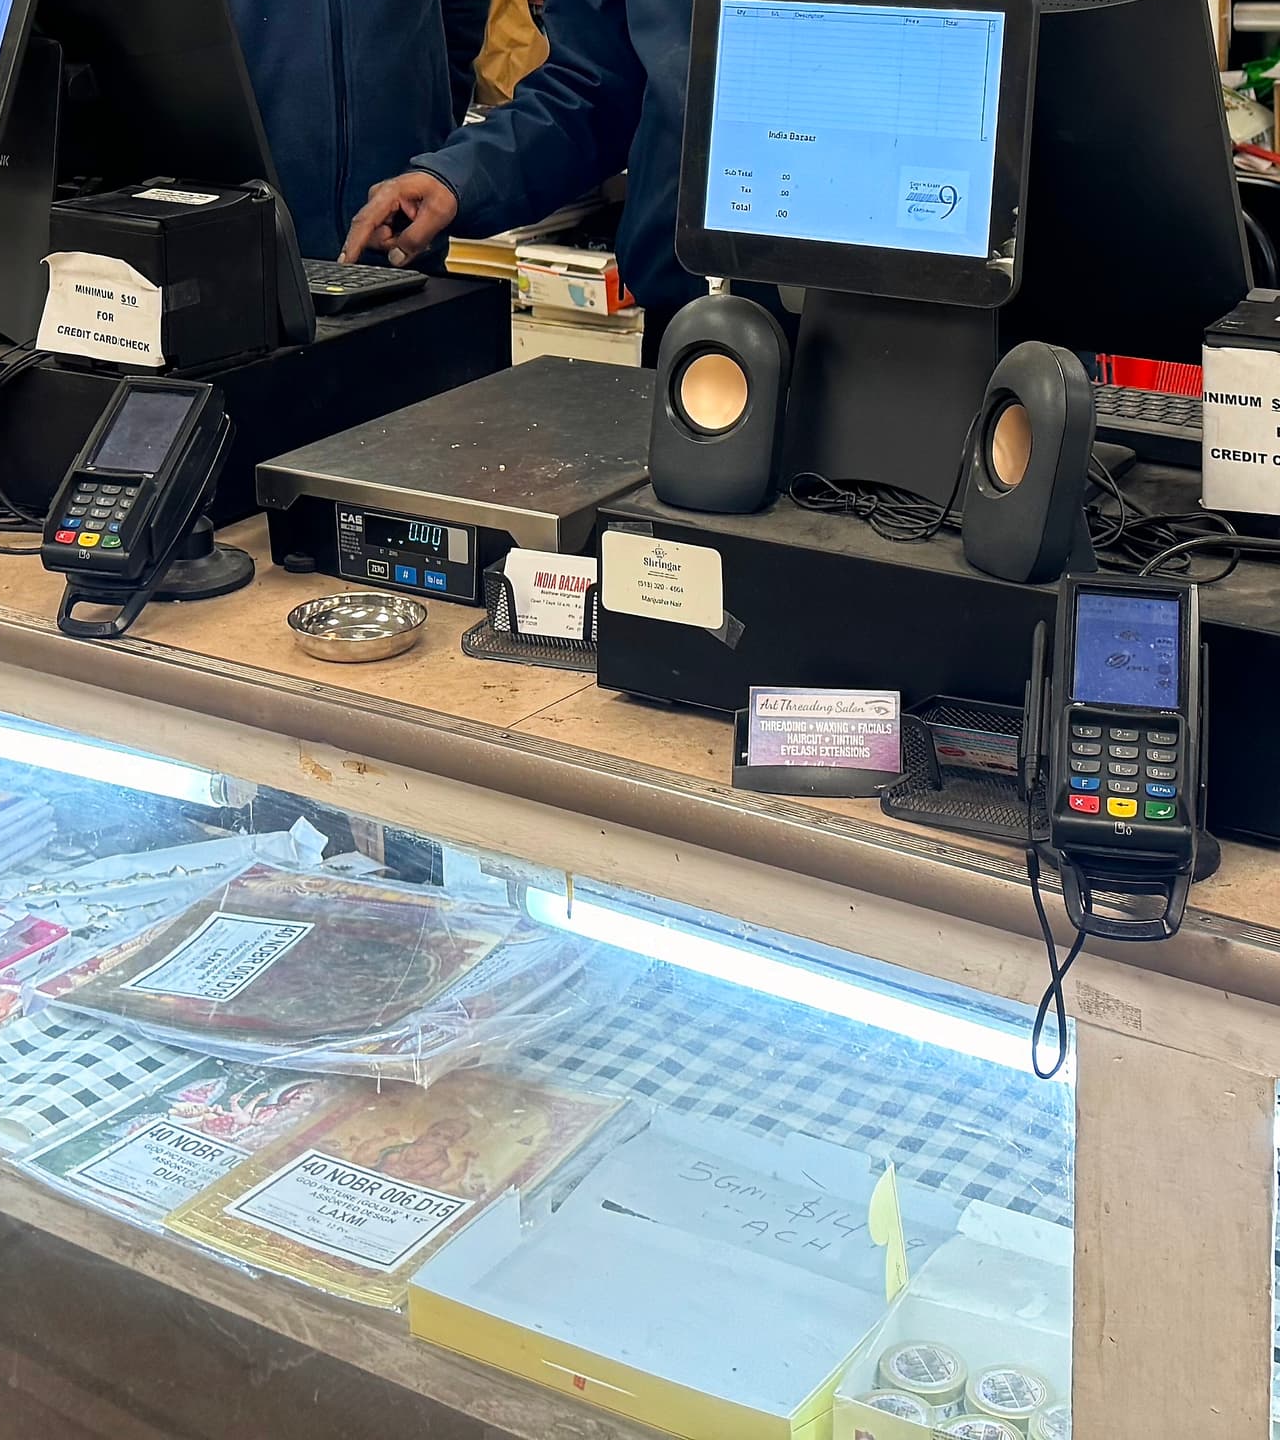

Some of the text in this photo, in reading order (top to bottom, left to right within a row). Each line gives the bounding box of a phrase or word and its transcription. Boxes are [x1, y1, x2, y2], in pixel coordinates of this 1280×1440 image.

[768, 130, 817, 143] India Bazaar
[724, 169, 753, 178] Sub Total
[731, 202, 751, 212] Total
[75, 284, 139, 307] MINIMUM $10
[96, 311, 114, 322] FOR
[57, 325, 91, 341] CREDIT
[1203, 391, 1262, 408] INIMUM
[1210, 448, 1268, 465] CREDIT
[340, 512, 363, 525] CAS
[409, 521, 442, 546] 0.00
[371, 564, 385, 574] ZERO
[643, 557, 682, 573] Shringar
[534, 571, 556, 589] INDIA
[760, 698, 866, 715] Art Threading Salon
[760, 722, 892, 734] THREADING WAXING FACIALS
[787, 734, 864, 746] HAIRCUT TINTING
[780, 745, 870, 758] EYELASH EXTENSIONS
[148, 1127, 224, 1162] 40 NOBR
[152, 1167, 205, 1192] DURGA
[295, 1176, 357, 1202] GOD PICTURE
[302, 1161, 456, 1218] 40 NOBR 006 D15
[309, 1191, 397, 1225] ASSORTED DESIGN
[317, 1205, 368, 1227] LAXMI
